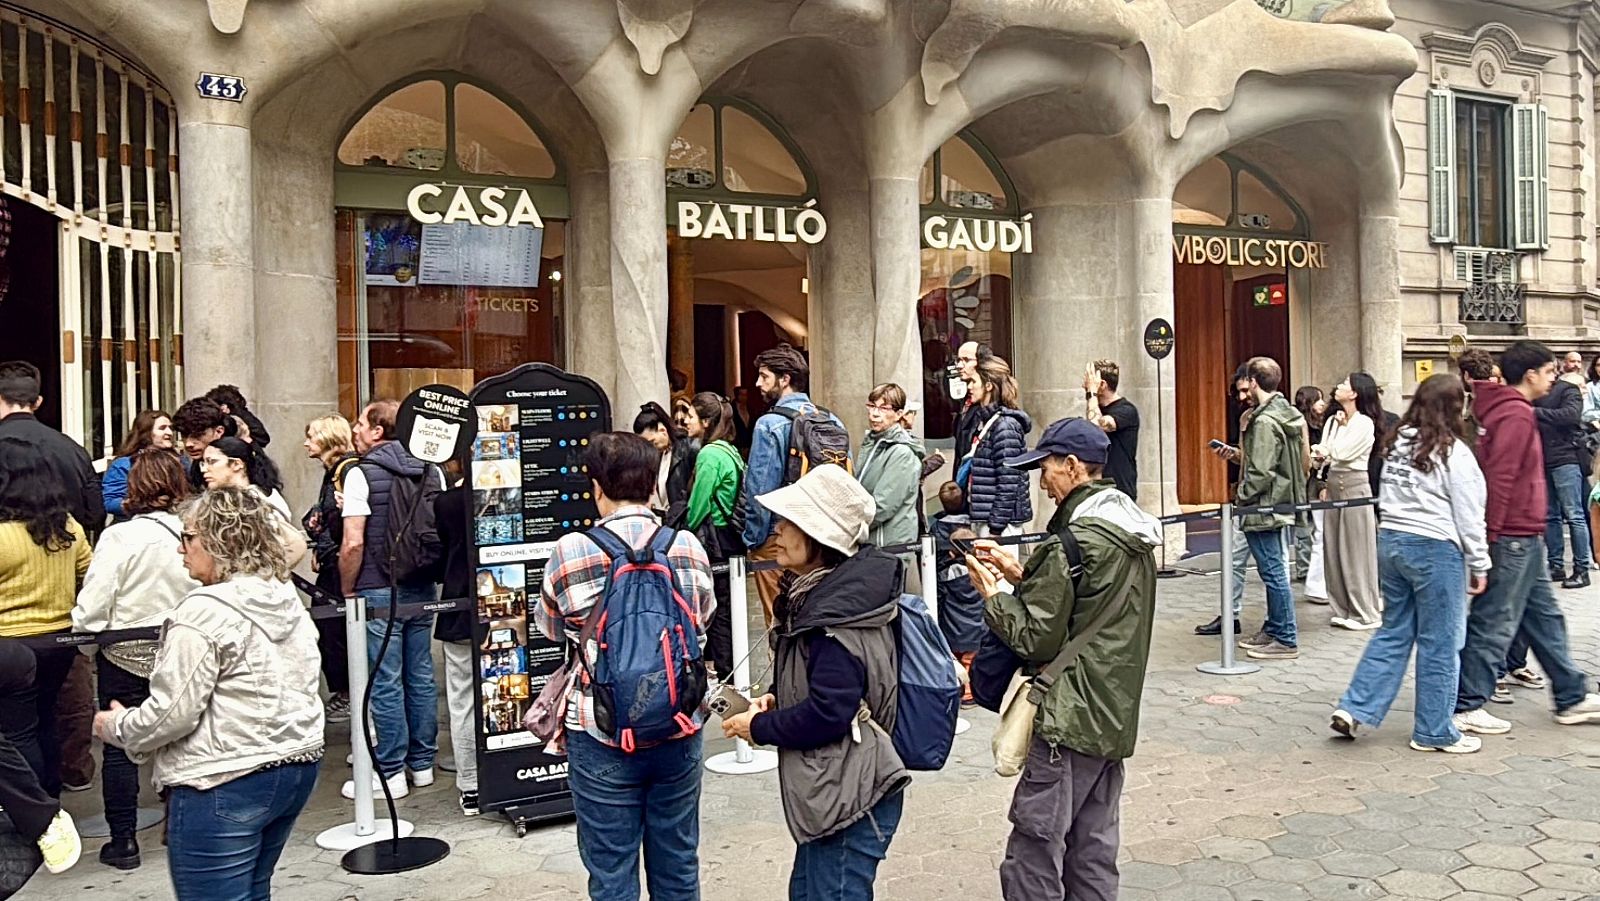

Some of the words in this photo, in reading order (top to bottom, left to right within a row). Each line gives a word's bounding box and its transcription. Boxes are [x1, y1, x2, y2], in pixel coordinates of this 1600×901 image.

[206, 76, 238, 98] 43
[407, 184, 544, 228] CASA
[678, 198, 827, 244] BATLLÓ
[924, 212, 1033, 253] GAUDÍ
[1265, 239, 1328, 268] STORE
[475, 296, 539, 312] TICKETS
[419, 389, 442, 402] BEST
[442, 394, 470, 409] PRICE
[506, 390, 532, 398] Choose
[532, 391, 548, 399] your
[548, 388, 568, 396] ticket
[424, 400, 461, 416] ONLINE
[435, 433, 452, 441] NOW
[517, 766, 547, 779] CASA
